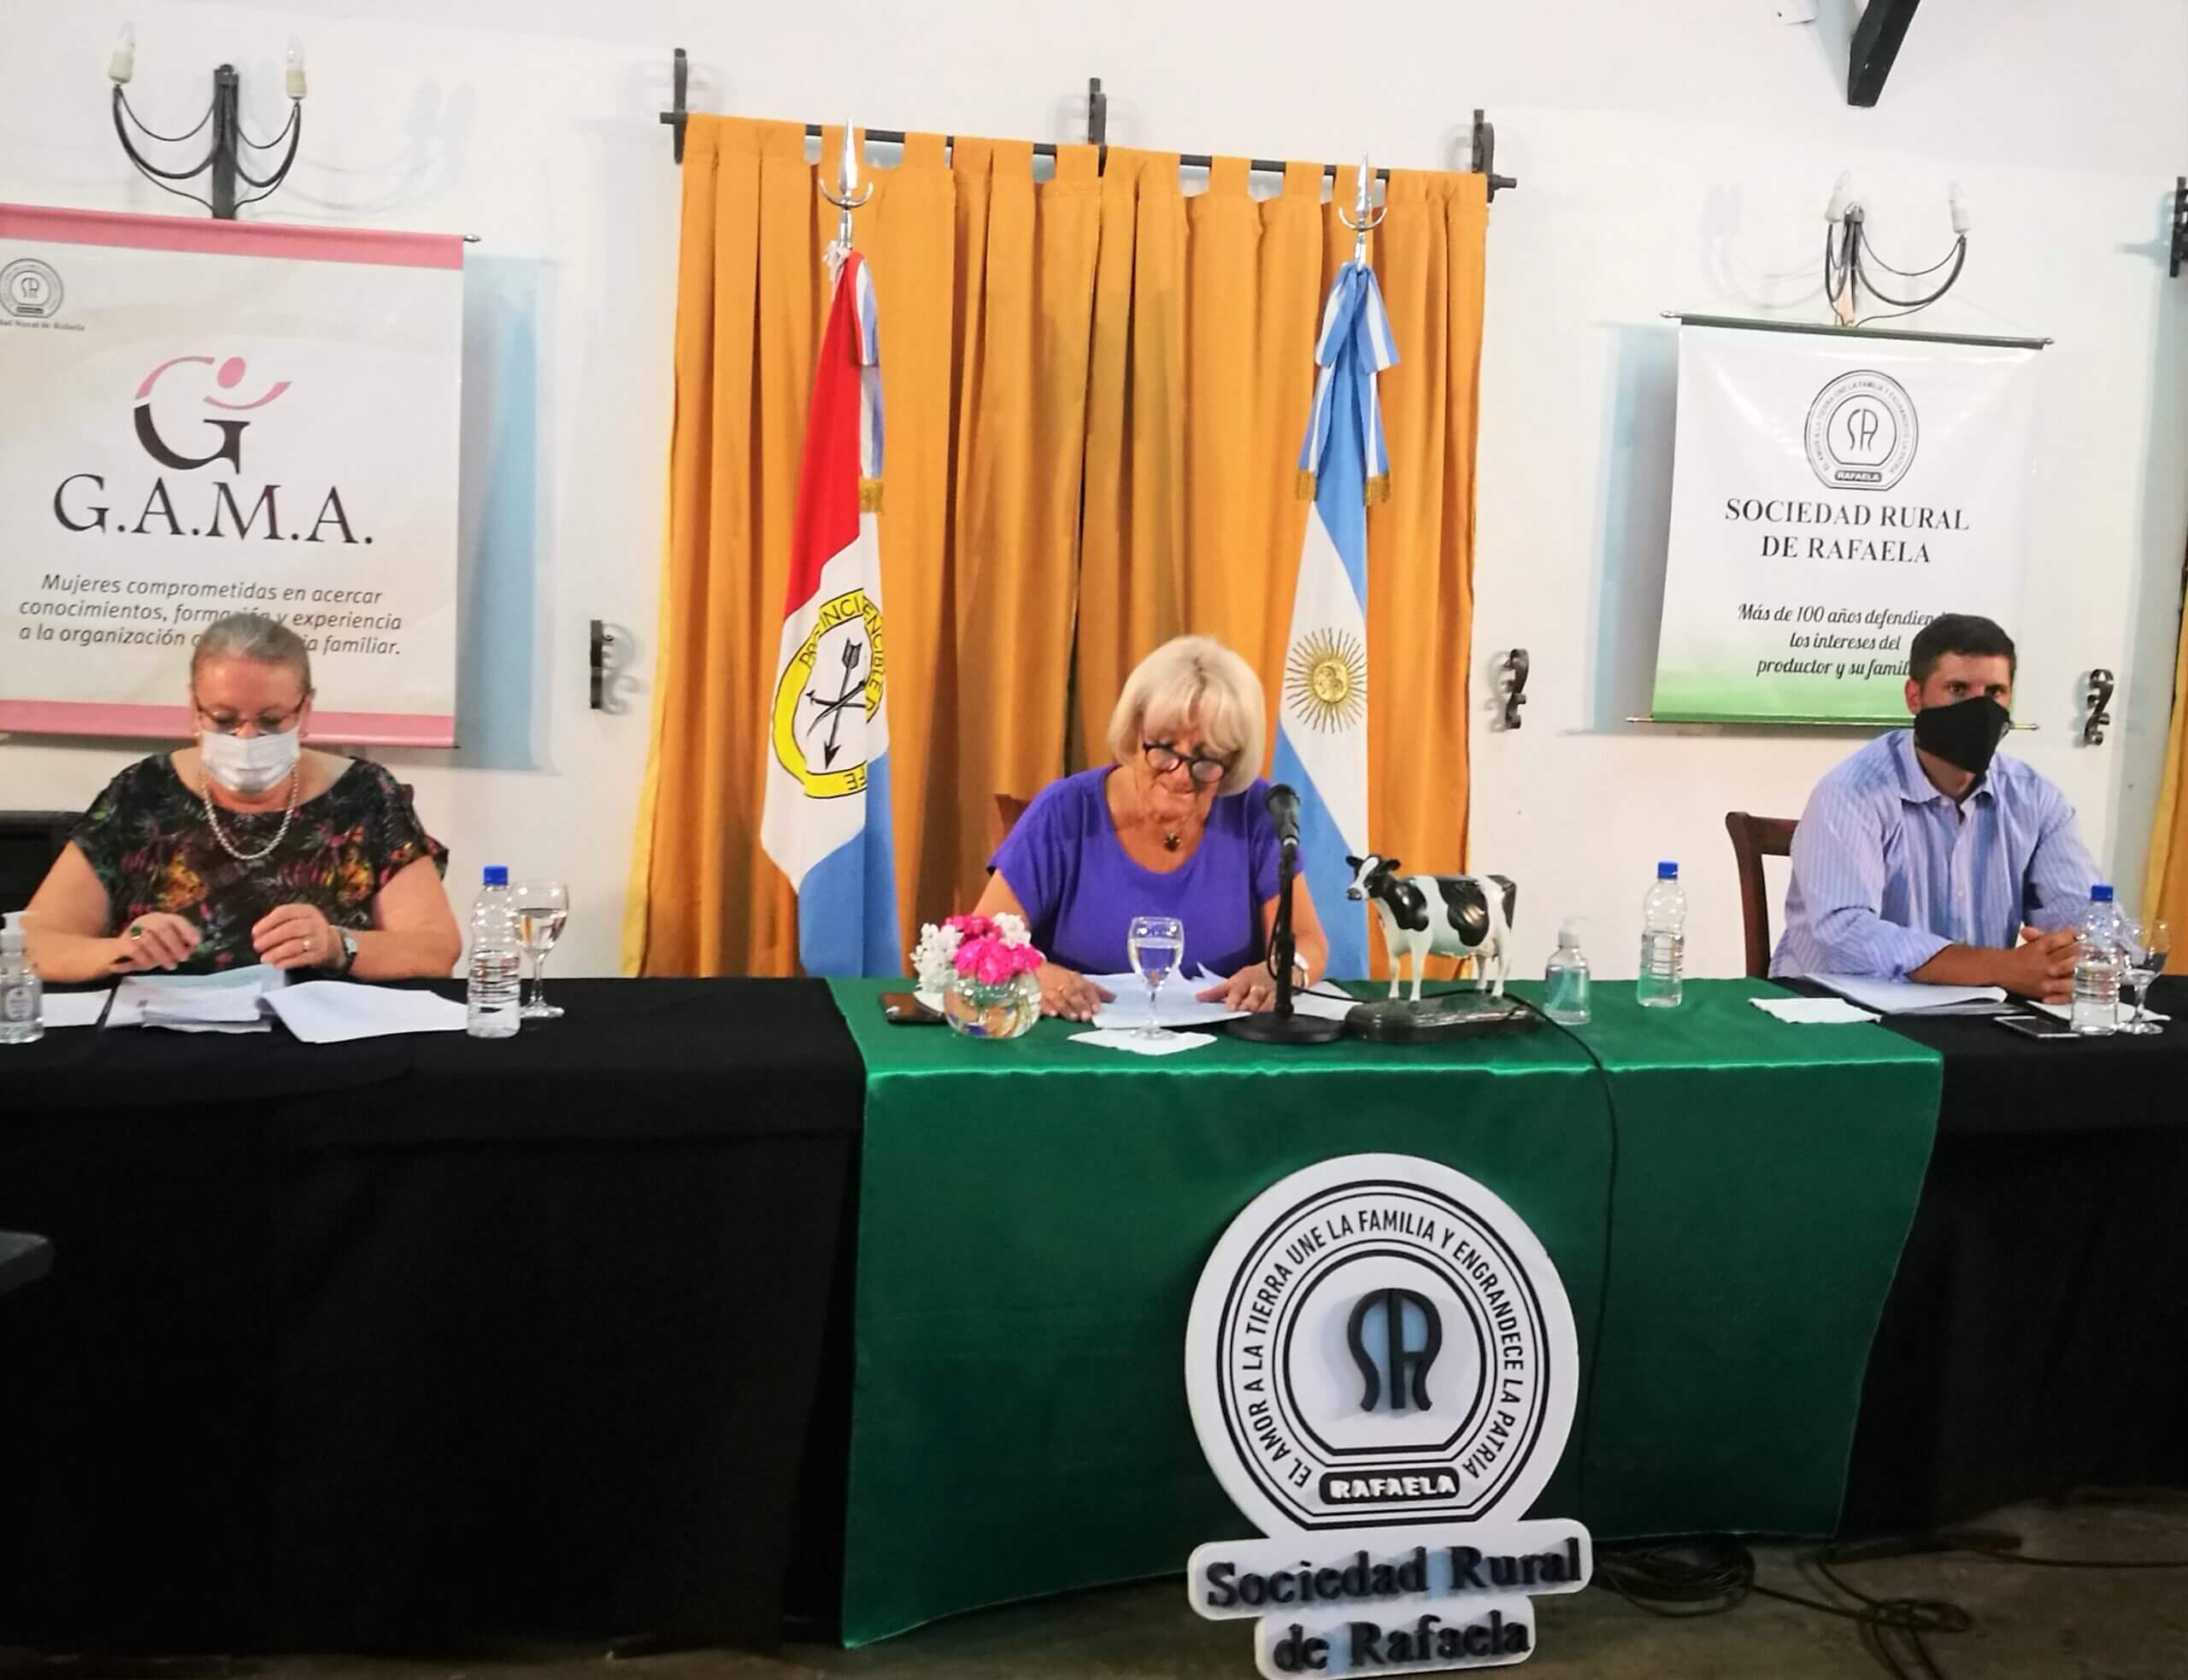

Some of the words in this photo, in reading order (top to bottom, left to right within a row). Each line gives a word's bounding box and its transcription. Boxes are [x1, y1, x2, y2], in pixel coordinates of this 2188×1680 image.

[53, 473, 373, 544] G.A.M.A.
[1725, 498, 1872, 526] SOCIEDAD
[1879, 506, 1969, 530] RURAL
[1762, 536, 1798, 557] DE
[1808, 537, 1931, 563] RAFAELA
[41, 573, 121, 595] Mujeres
[126, 579, 277, 601] comprometidas
[283, 588, 306, 601] en
[312, 589, 383, 604] acercar
[20, 600, 168, 622] conocimientos,
[293, 612, 402, 630] experiencia
[1738, 603, 1770, 621] Más
[1773, 607, 1793, 621] de
[1797, 606, 1825, 623] 100
[1827, 608, 1862, 624] años
[20, 626, 31, 640] a
[37, 624, 55, 641] la
[60, 628, 185, 647] organización
[322, 636, 401, 655] familiar.
[1790, 632, 1809, 648] los
[1813, 632, 1876, 650] intereses
[1879, 635, 1902, 650] del
[1756, 658, 1833, 678] productor
[1836, 664, 1846, 680] y
[1848, 664, 1865, 676] su
[1326, 1214, 1354, 1240] LA
[1358, 1209, 1435, 1242] FAMILIA
[1441, 1227, 1455, 1249] Y
[1285, 1226, 1326, 1265] UNE
[1245, 1263, 1293, 1336] TIERRA
[1453, 1241, 1524, 1371] ENGRANDECE
[1242, 1345, 1263, 1370] LA
[1244, 1377, 1265, 1392] A
[1501, 1378, 1523, 1404] LA
[1249, 1399, 1291, 1462] AMOR
[1462, 1410, 1516, 1479] PATRIA
[1288, 1458, 1312, 1489] EL
[1329, 1475, 1456, 1499] RAFAELA
[1207, 1547, 1430, 1607] Sociedad
[1448, 1536, 1581, 1591] Rural
[1273, 1624, 1329, 1672] de
[1349, 1609, 1531, 1668] Rafaela
